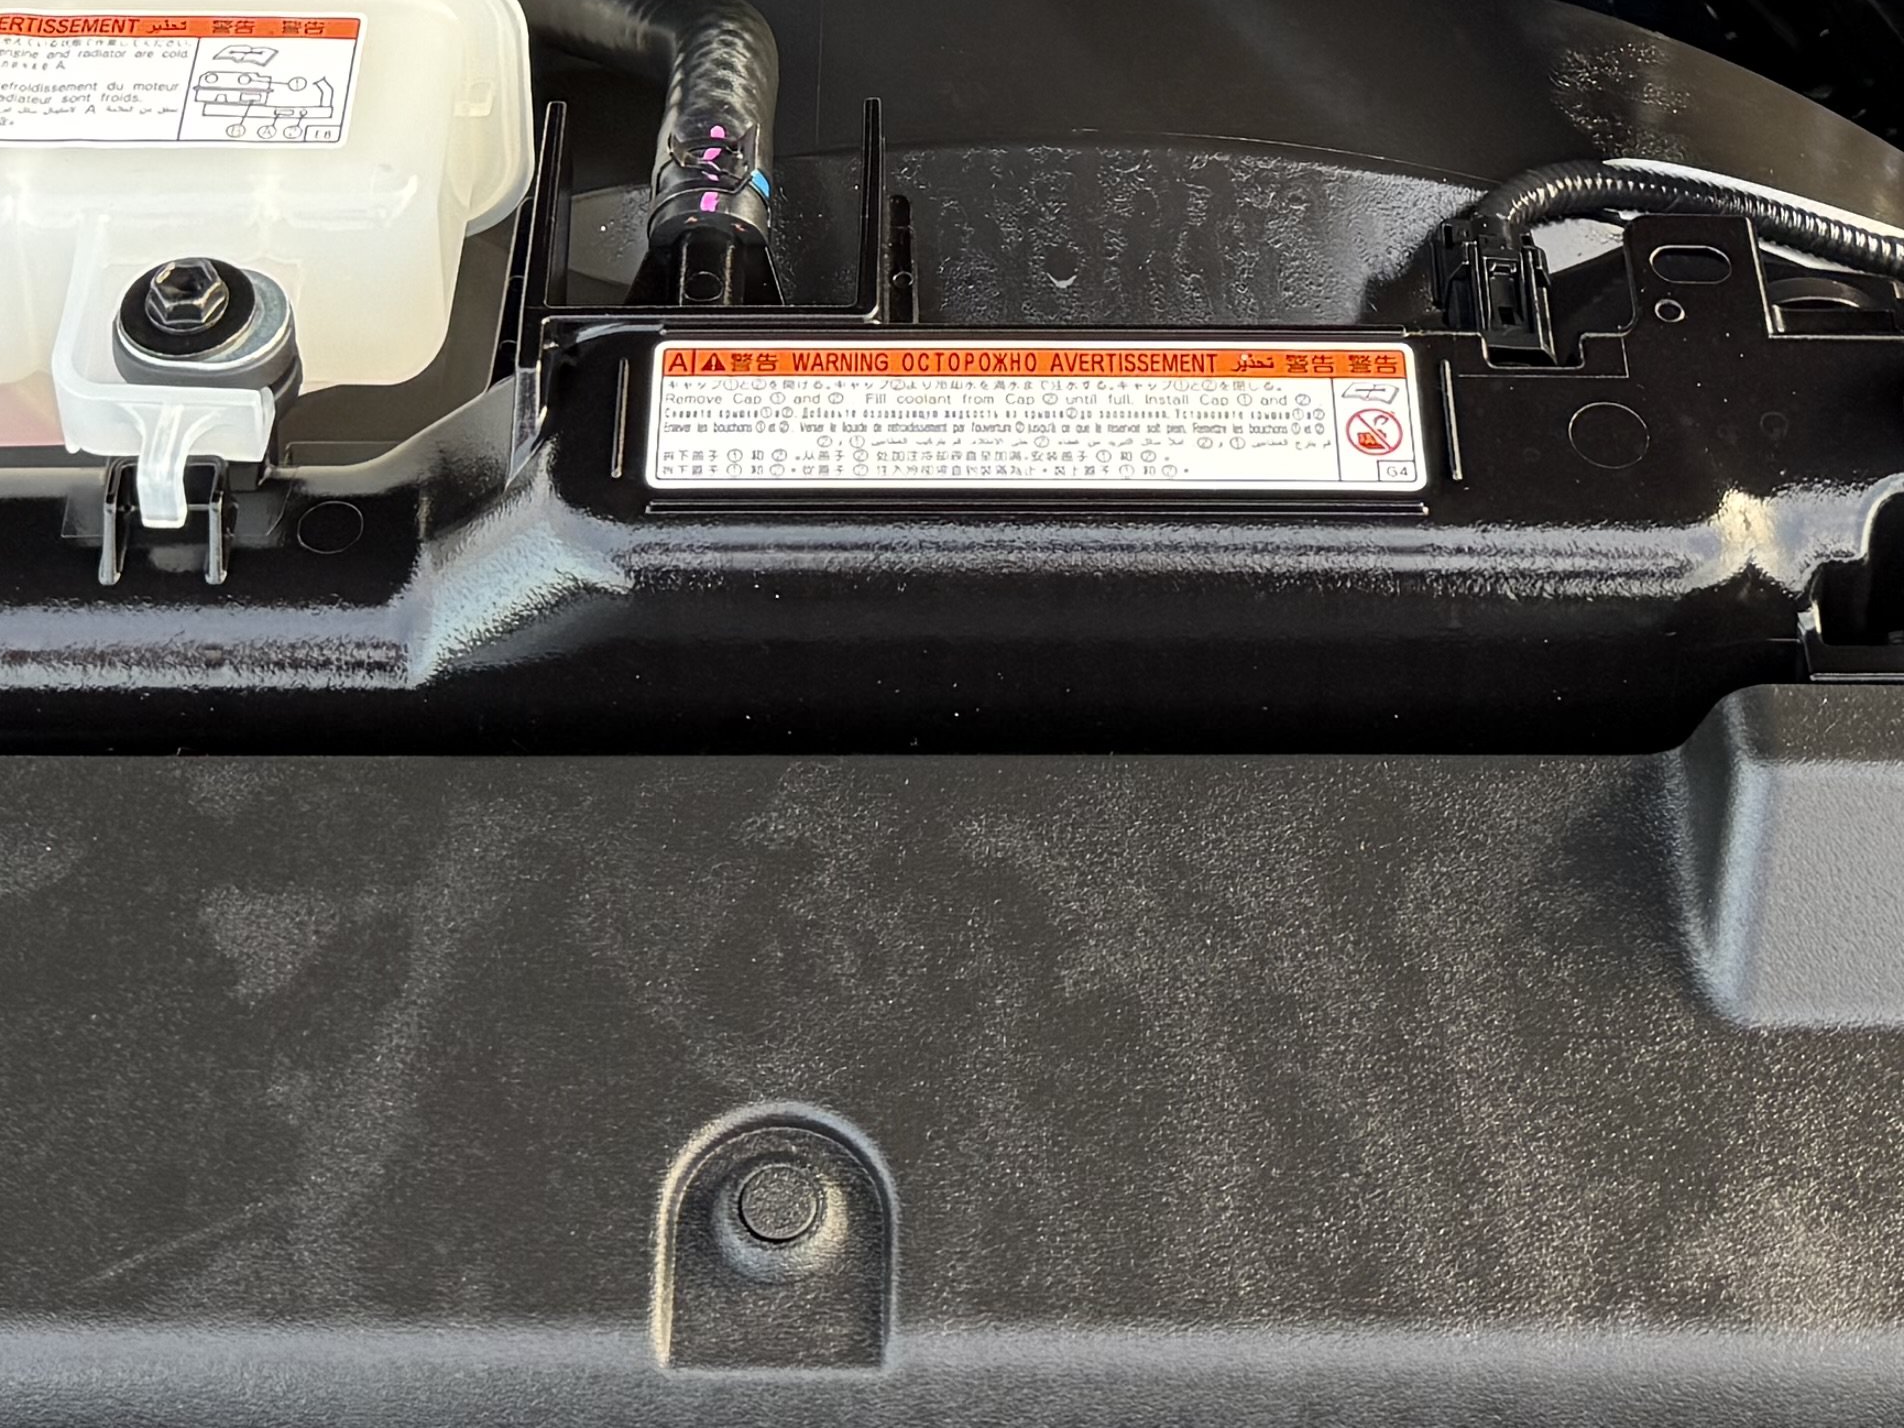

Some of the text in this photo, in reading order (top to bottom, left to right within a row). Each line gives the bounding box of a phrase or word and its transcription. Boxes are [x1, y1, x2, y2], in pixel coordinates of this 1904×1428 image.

[47, 49, 70, 59] and
[78, 50, 126, 58] radiator
[134, 50, 153, 58] are
[107, 82, 124, 91] du
[133, 82, 180, 91] moteur
[61, 94, 91, 103] sont
[668, 352, 688, 372] A
[792, 352, 889, 372] WARNING
[902, 352, 1037, 372] ОСТОРОЖНО
[1050, 352, 1218, 373] AVERTISSEMENT
[666, 393, 722, 405] Remove
[733, 393, 762, 407] Cap
[794, 394, 821, 405] and
[866, 394, 887, 405] Fill
[897, 394, 951, 405] coolant
[963, 394, 994, 405] from
[1006, 394, 1035, 407] Cap
[1066, 394, 1097, 406] until
[1146, 394, 1189, 406] Install
[1200, 394, 1229, 407] Cap
[1261, 394, 1287, 406] and
